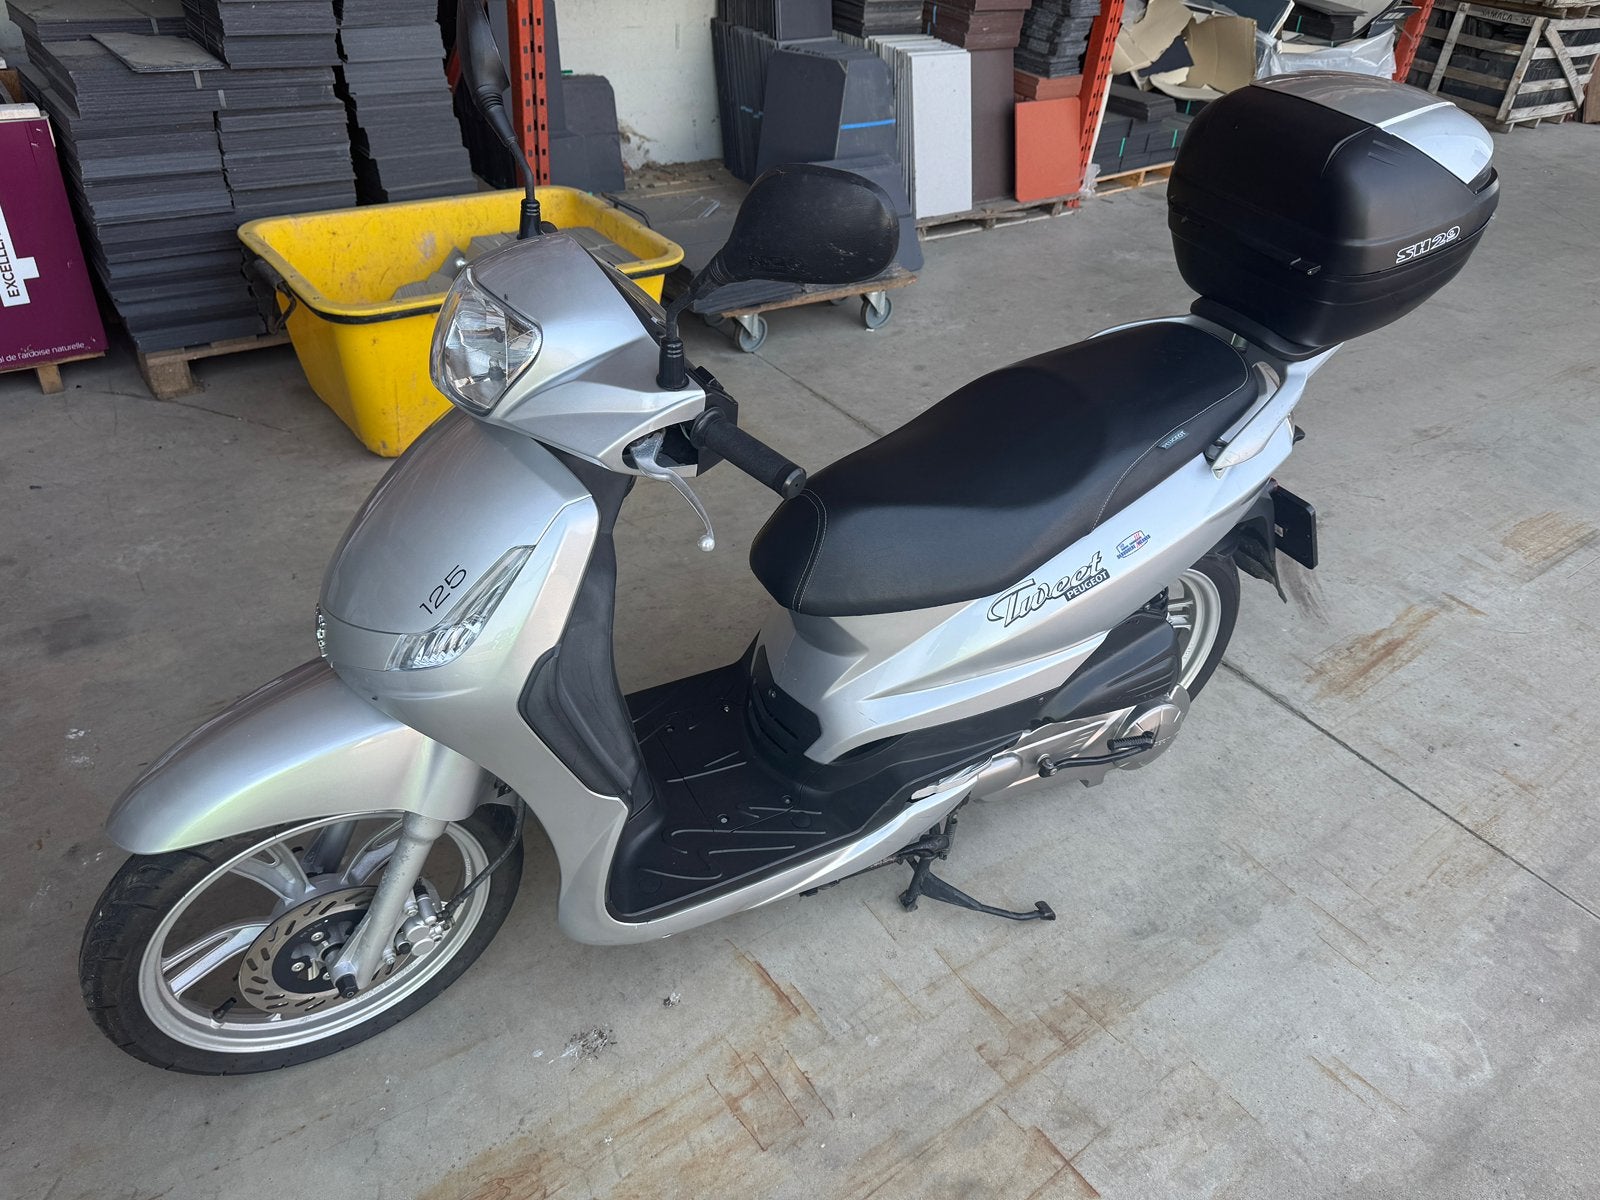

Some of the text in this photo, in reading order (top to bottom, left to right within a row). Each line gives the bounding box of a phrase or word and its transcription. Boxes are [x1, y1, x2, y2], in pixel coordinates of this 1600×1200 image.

[1395, 225, 1461, 264] SH29
[51, 342, 84, 353] naturelle
[419, 564, 467, 615] 125
[986, 550, 1103, 628] Tweet
[1066, 570, 1109, 600] PEUGEOT
